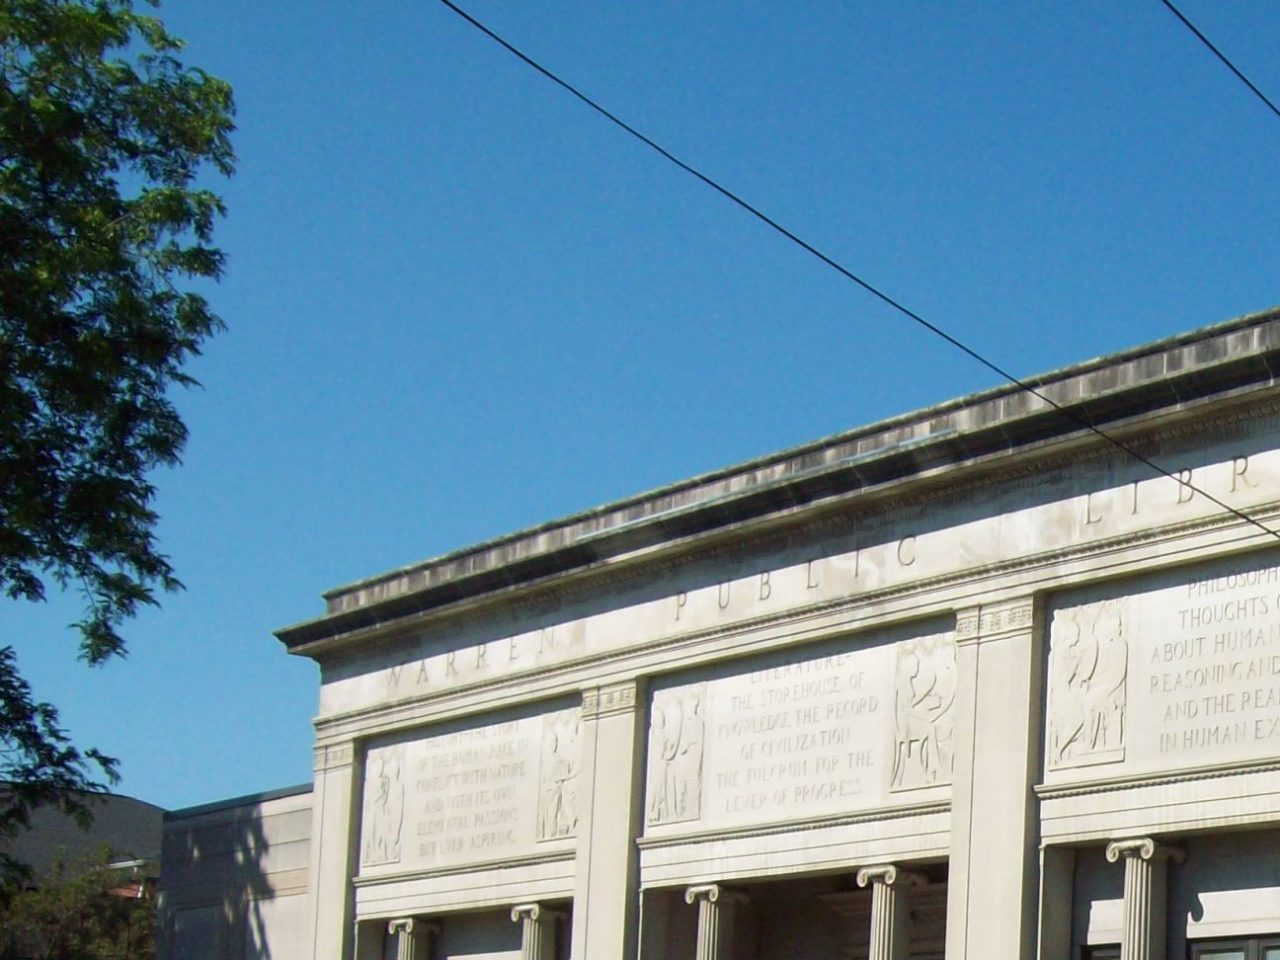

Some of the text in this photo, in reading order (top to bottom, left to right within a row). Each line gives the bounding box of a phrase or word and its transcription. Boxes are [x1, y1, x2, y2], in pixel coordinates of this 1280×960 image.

[387, 628, 560, 688] WARREN
[675, 534, 917, 621] PUBLIC
[1178, 595, 1269, 629] THOUGHTS
[1150, 636, 1207, 665] ABOUT
[730, 693, 755, 713] THE
[849, 671, 866, 689] OF
[1149, 661, 1243, 694] REASONING
[794, 705, 820, 726] THE
[1164, 699, 1199, 723] AND
[1203, 692, 1236, 716] THE
[740, 742, 757, 760] OF
[1159, 732, 1177, 753] IN
[1182, 720, 1247, 750] HUMAN
[716, 770, 740, 790] THE
[847, 749, 875, 769] THE
[773, 787, 788, 806] OF
